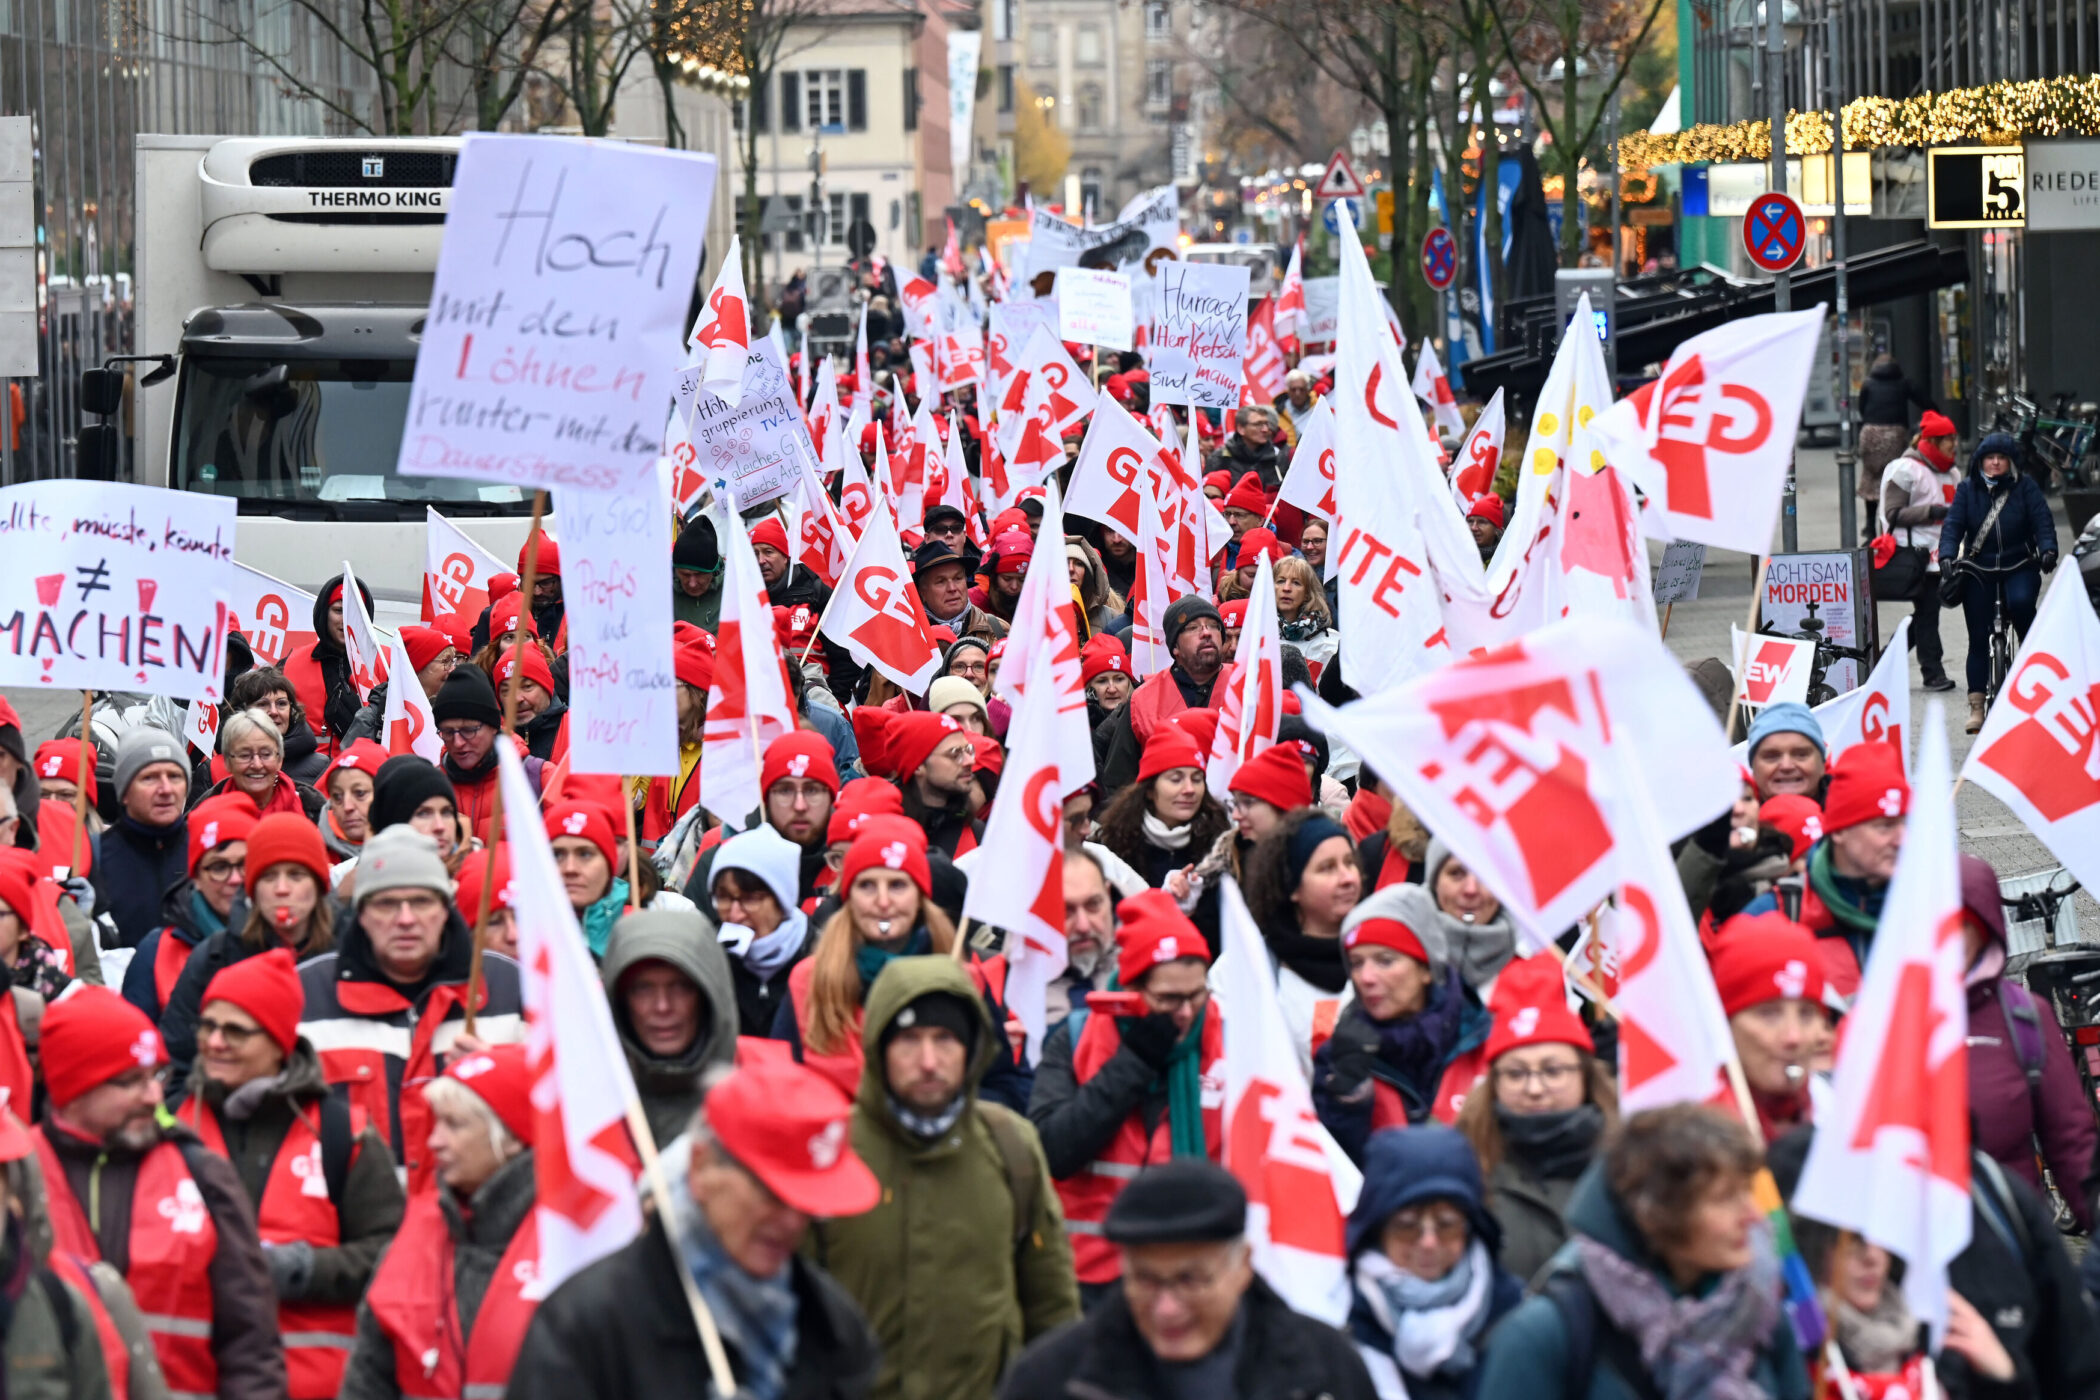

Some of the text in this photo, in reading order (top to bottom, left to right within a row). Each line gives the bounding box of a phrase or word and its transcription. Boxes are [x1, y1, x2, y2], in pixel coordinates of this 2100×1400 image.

[308, 191, 441, 207] THERMO KING
[494, 158, 671, 290] Hoch
[435, 291, 619, 342] mit den
[1157, 325, 1188, 348] Herr
[455, 333, 646, 401] Löhnen
[1195, 364, 1237, 393] mann
[1190, 383, 1214, 402] Sie
[701, 396, 785, 443] gruppierung
[760, 408, 796, 432] TV-L
[731, 451, 781, 486] gleiches
[741, 478, 779, 506] gleiche
[1765, 562, 1849, 584] ACHTSAM
[1768, 583, 1848, 604] MORDEN
